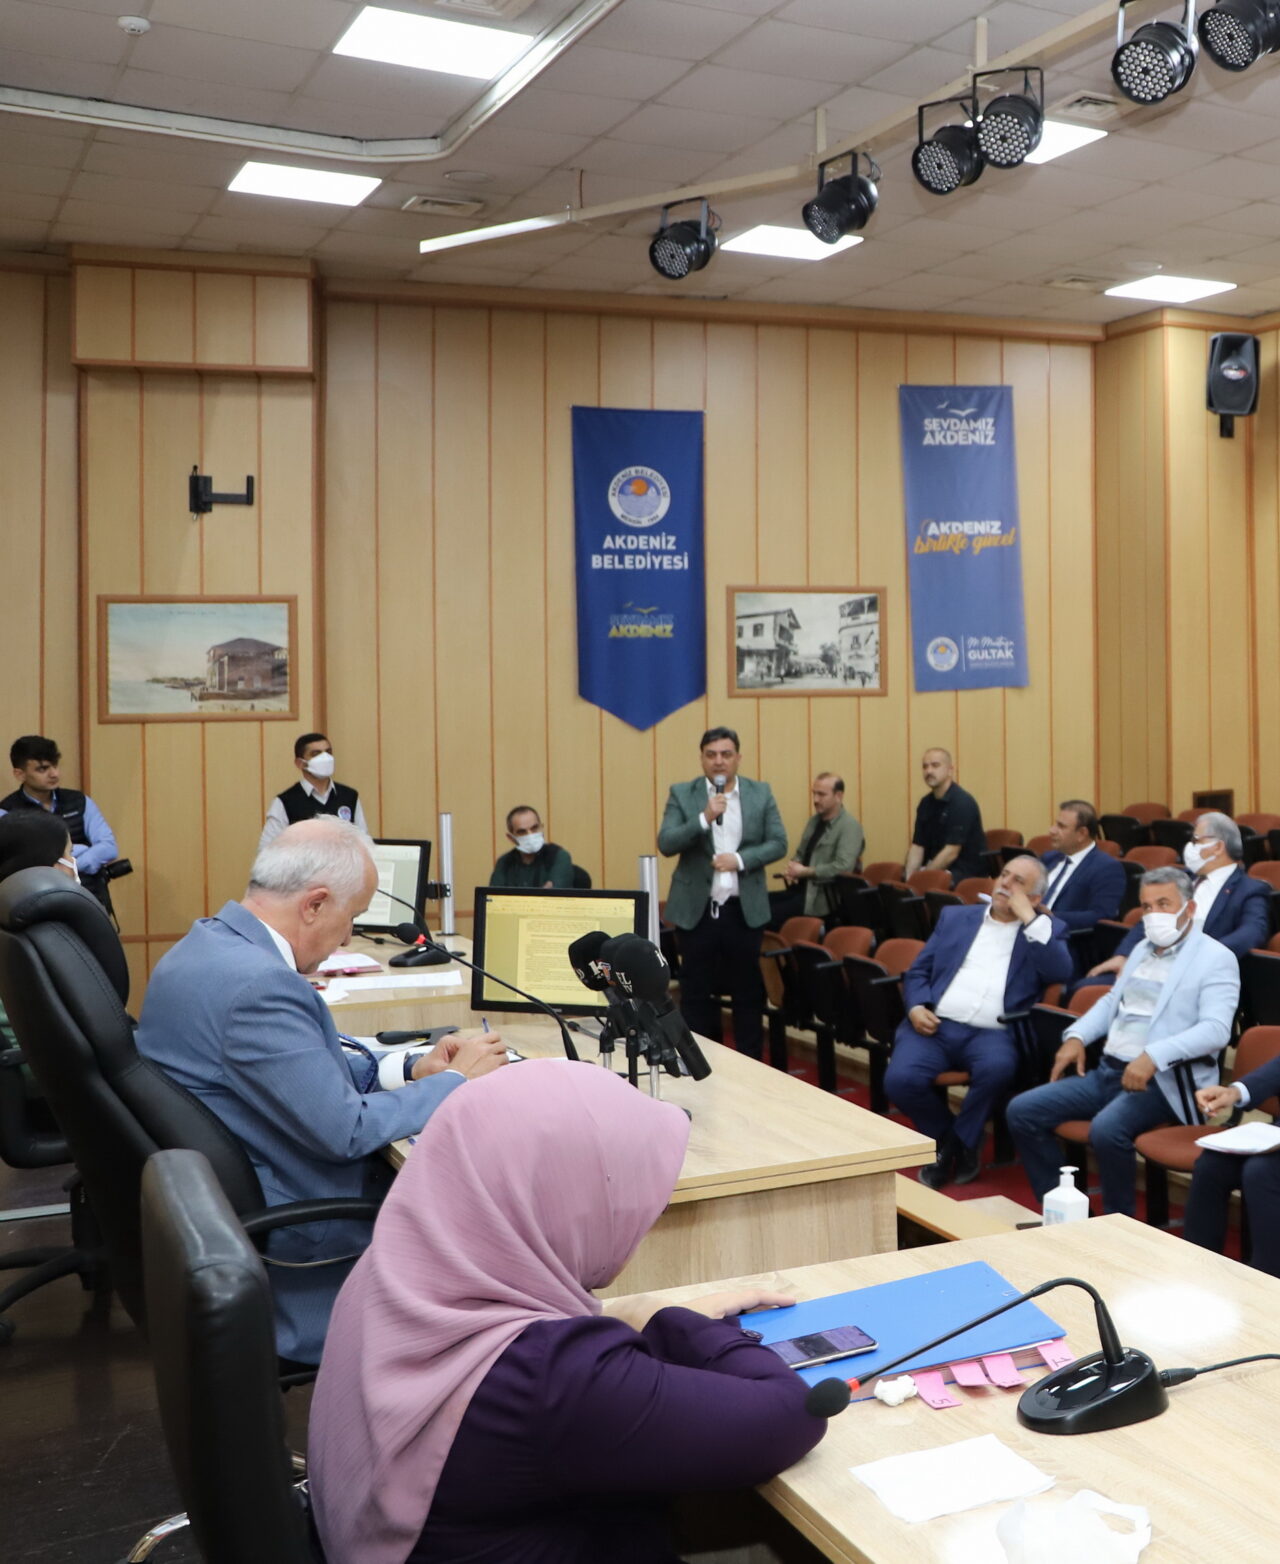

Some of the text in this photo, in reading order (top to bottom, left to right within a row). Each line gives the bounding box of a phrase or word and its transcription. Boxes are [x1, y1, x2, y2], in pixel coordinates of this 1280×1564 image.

[924, 417, 995, 431] SEVDAMIZ
[602, 531, 677, 550] AKDENİZ
[591, 551, 689, 570] BELEDİYESİ
